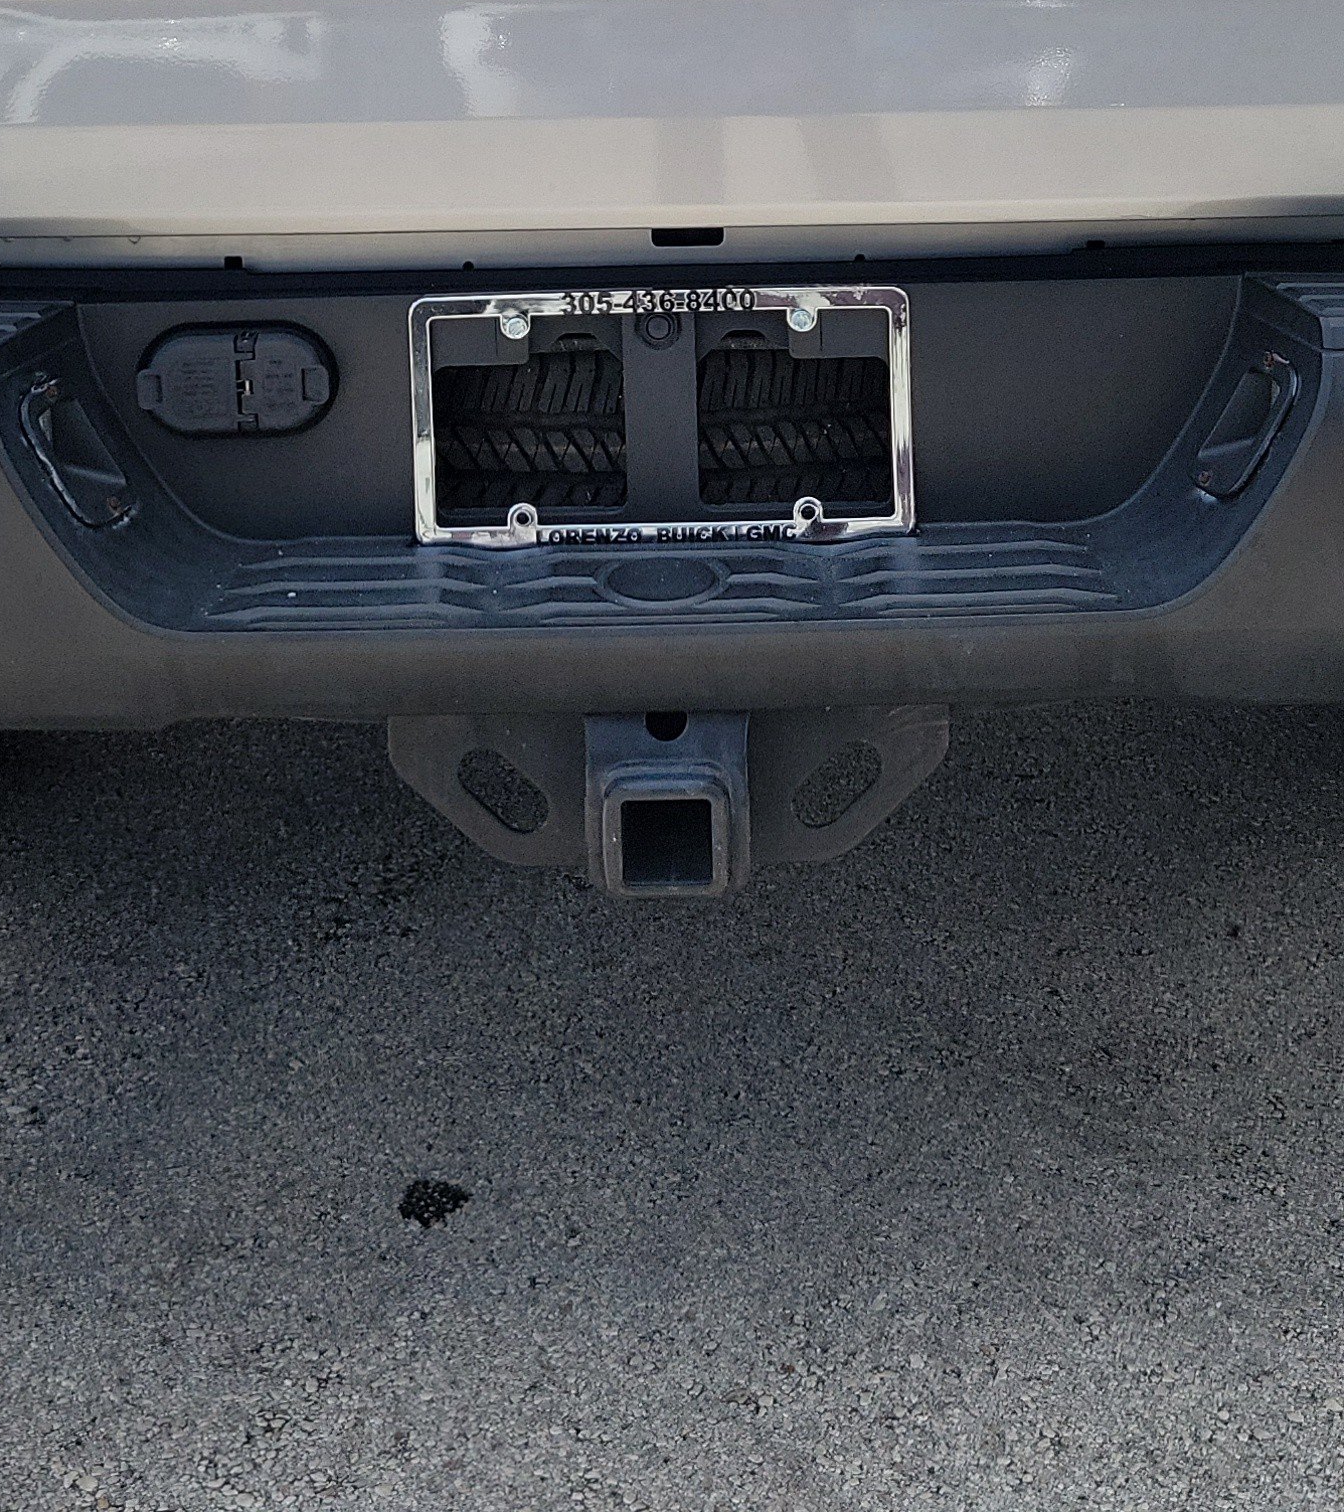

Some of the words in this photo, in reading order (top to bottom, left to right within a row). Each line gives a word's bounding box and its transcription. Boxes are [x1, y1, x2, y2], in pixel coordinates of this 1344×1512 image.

[560, 289, 756, 315] 305-436-8400
[535, 526, 643, 545] LORENZO
[656, 525, 729, 544] BUICK
[746, 523, 797, 541] GMC
